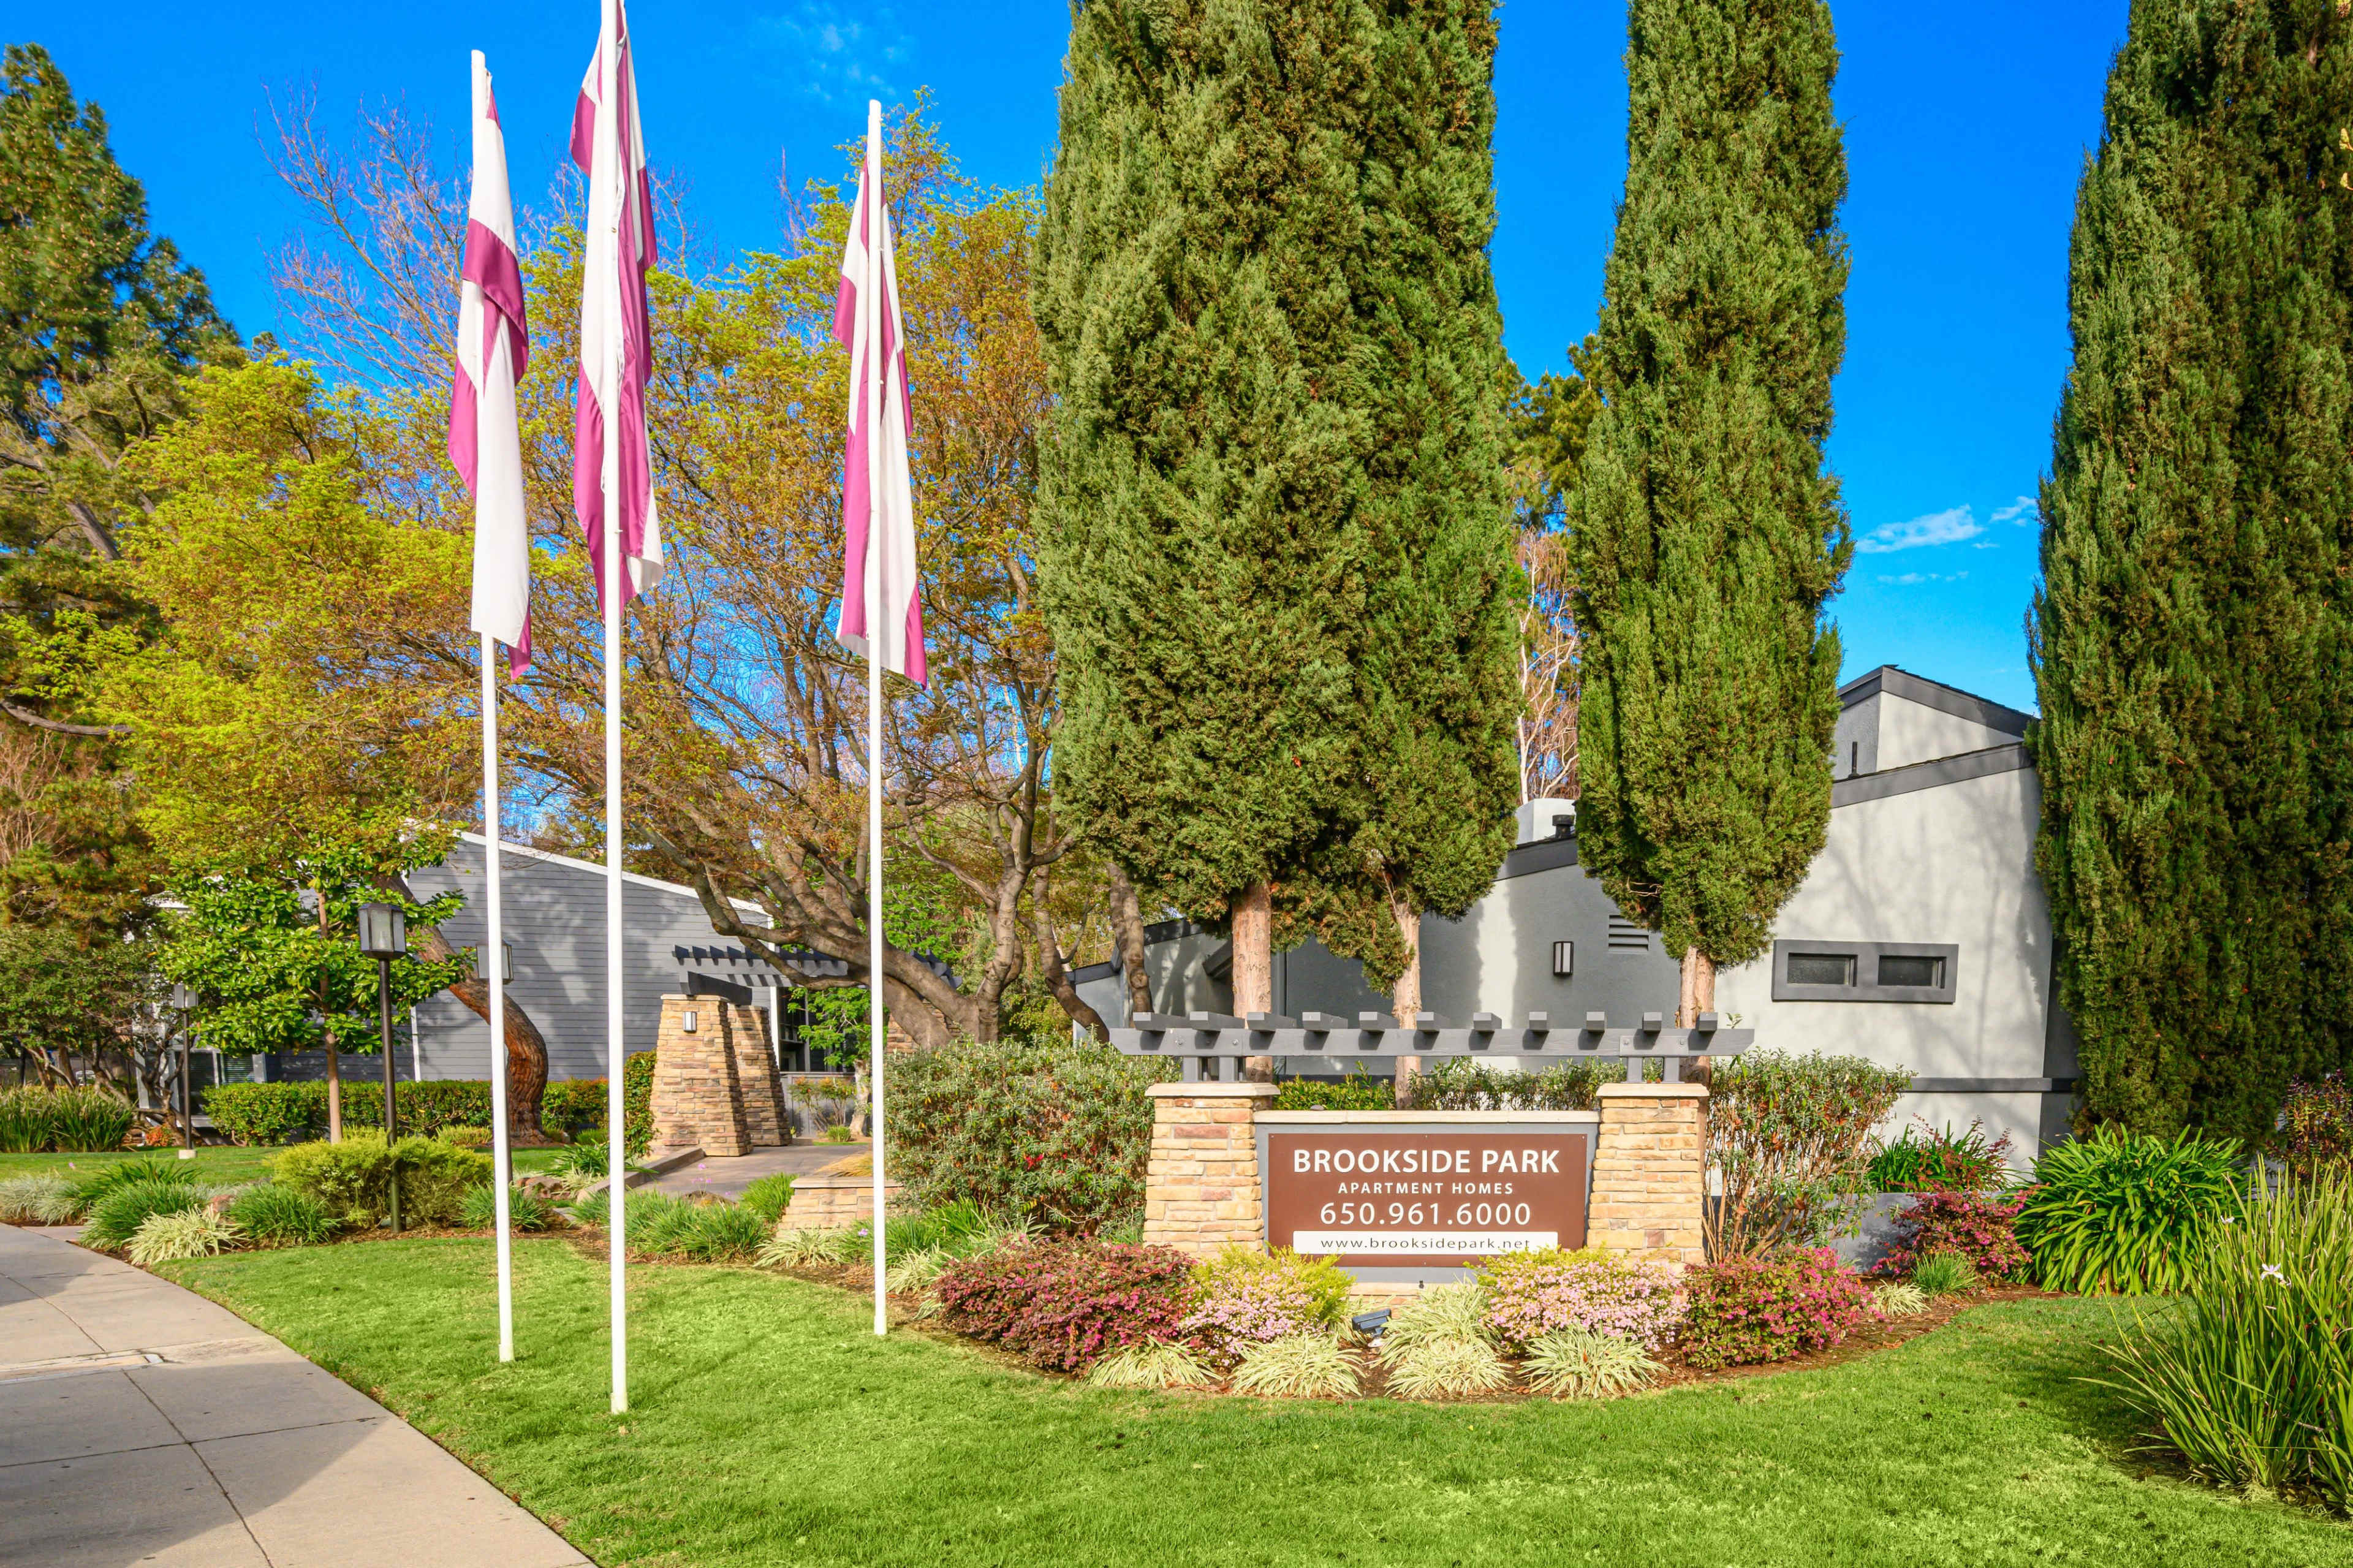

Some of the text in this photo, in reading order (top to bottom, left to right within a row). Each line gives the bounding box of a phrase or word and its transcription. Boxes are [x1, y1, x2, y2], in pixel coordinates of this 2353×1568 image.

[1294, 1149, 1559, 1173] BROOKSIDE PARK
[1338, 1182, 1513, 1194] APARTMENT HOMES
[1320, 1202, 1531, 1225] 650.961.6000
[1321, 1238, 1530, 1251] www.brooksidepark.net
